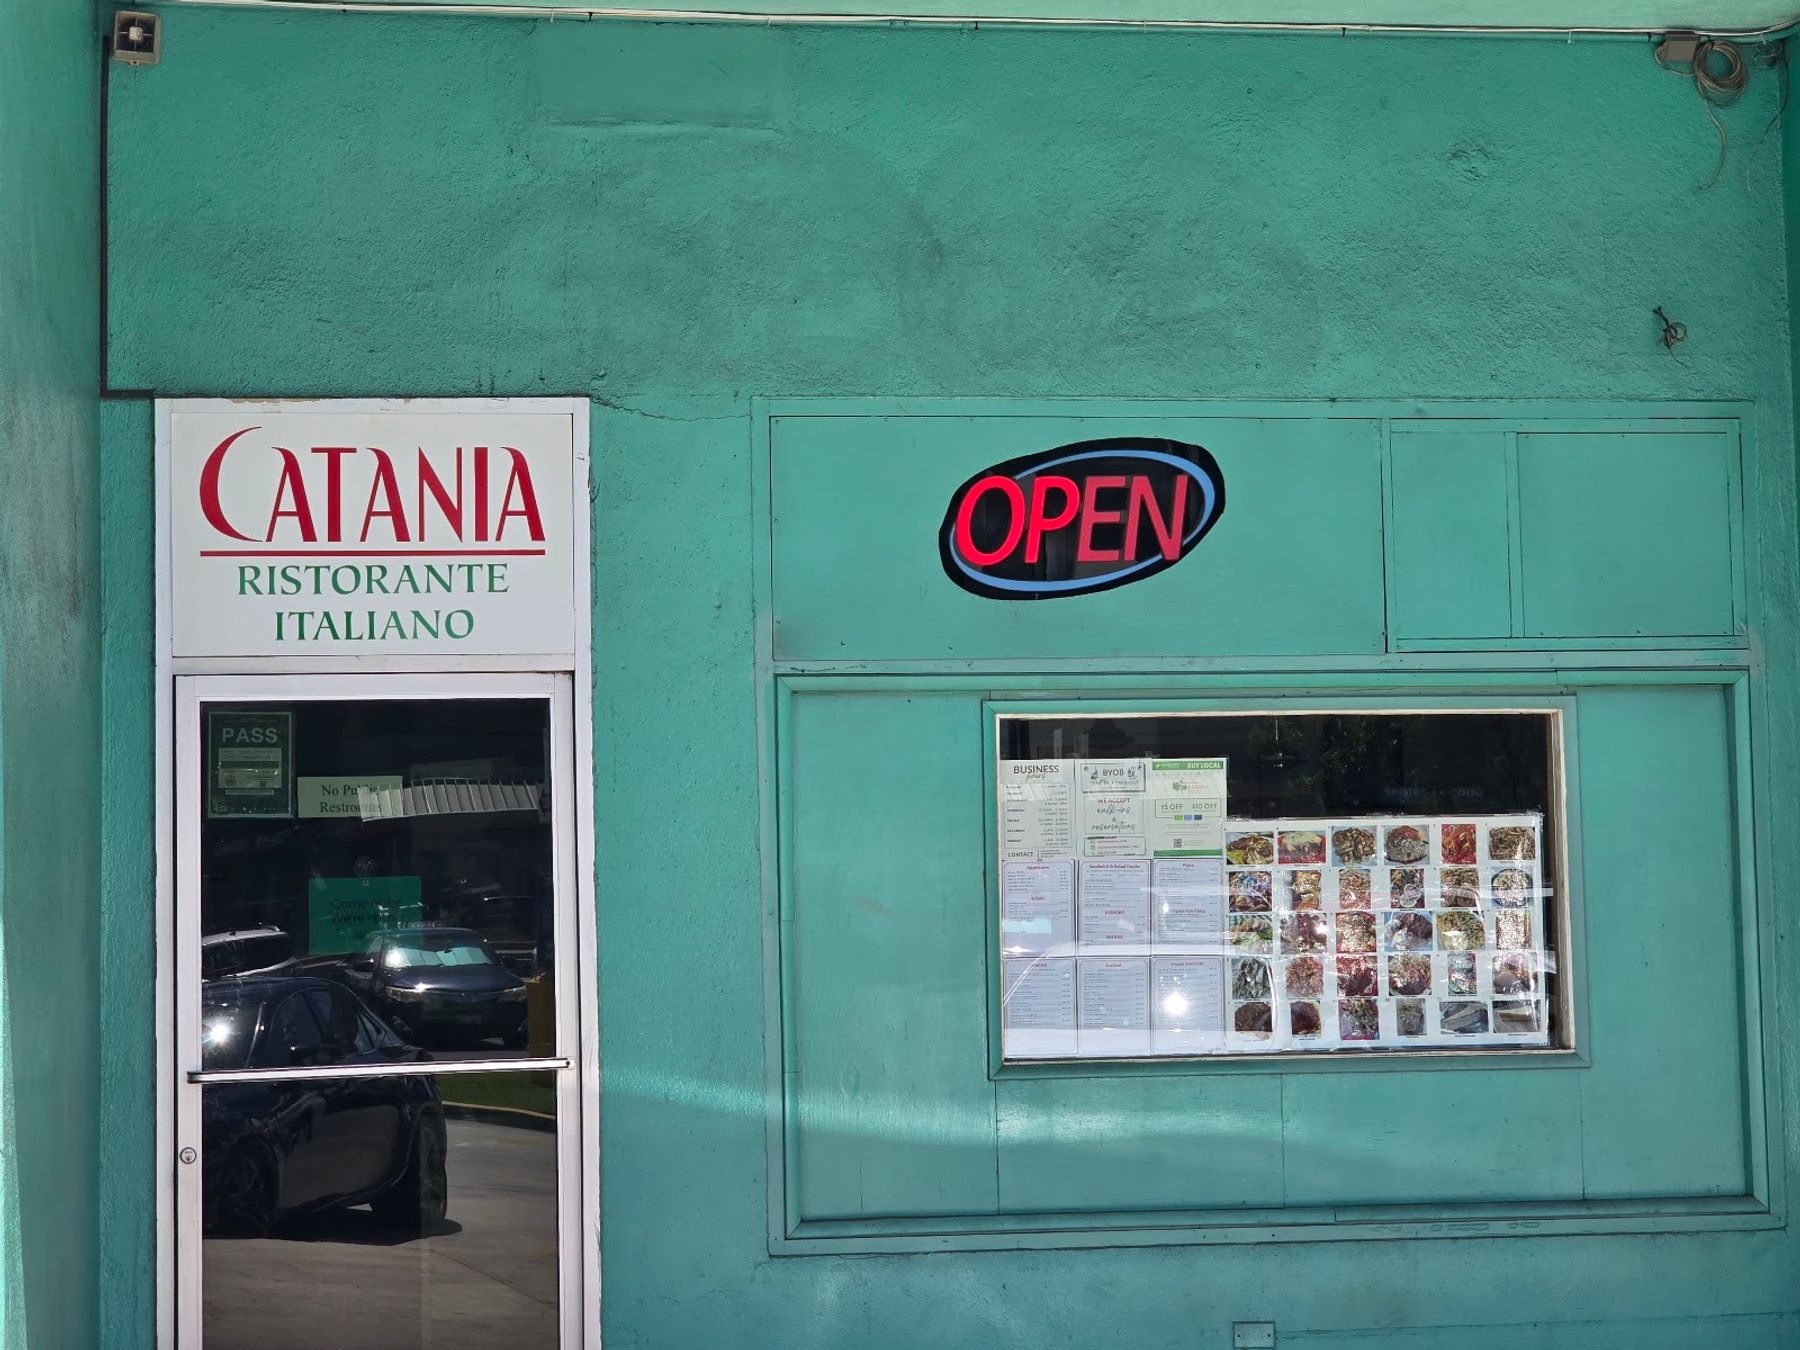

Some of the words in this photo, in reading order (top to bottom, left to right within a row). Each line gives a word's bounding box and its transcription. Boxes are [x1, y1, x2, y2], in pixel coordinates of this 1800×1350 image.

[199, 426, 546, 542] CATANIA
[955, 475, 1188, 566] OPEN
[238, 563, 510, 595] RISTORANTE
[275, 609, 474, 641] ITALIANO
[222, 727, 278, 743] PASS
[1013, 765, 1060, 774] BUSINESS
[321, 784, 339, 796] No
